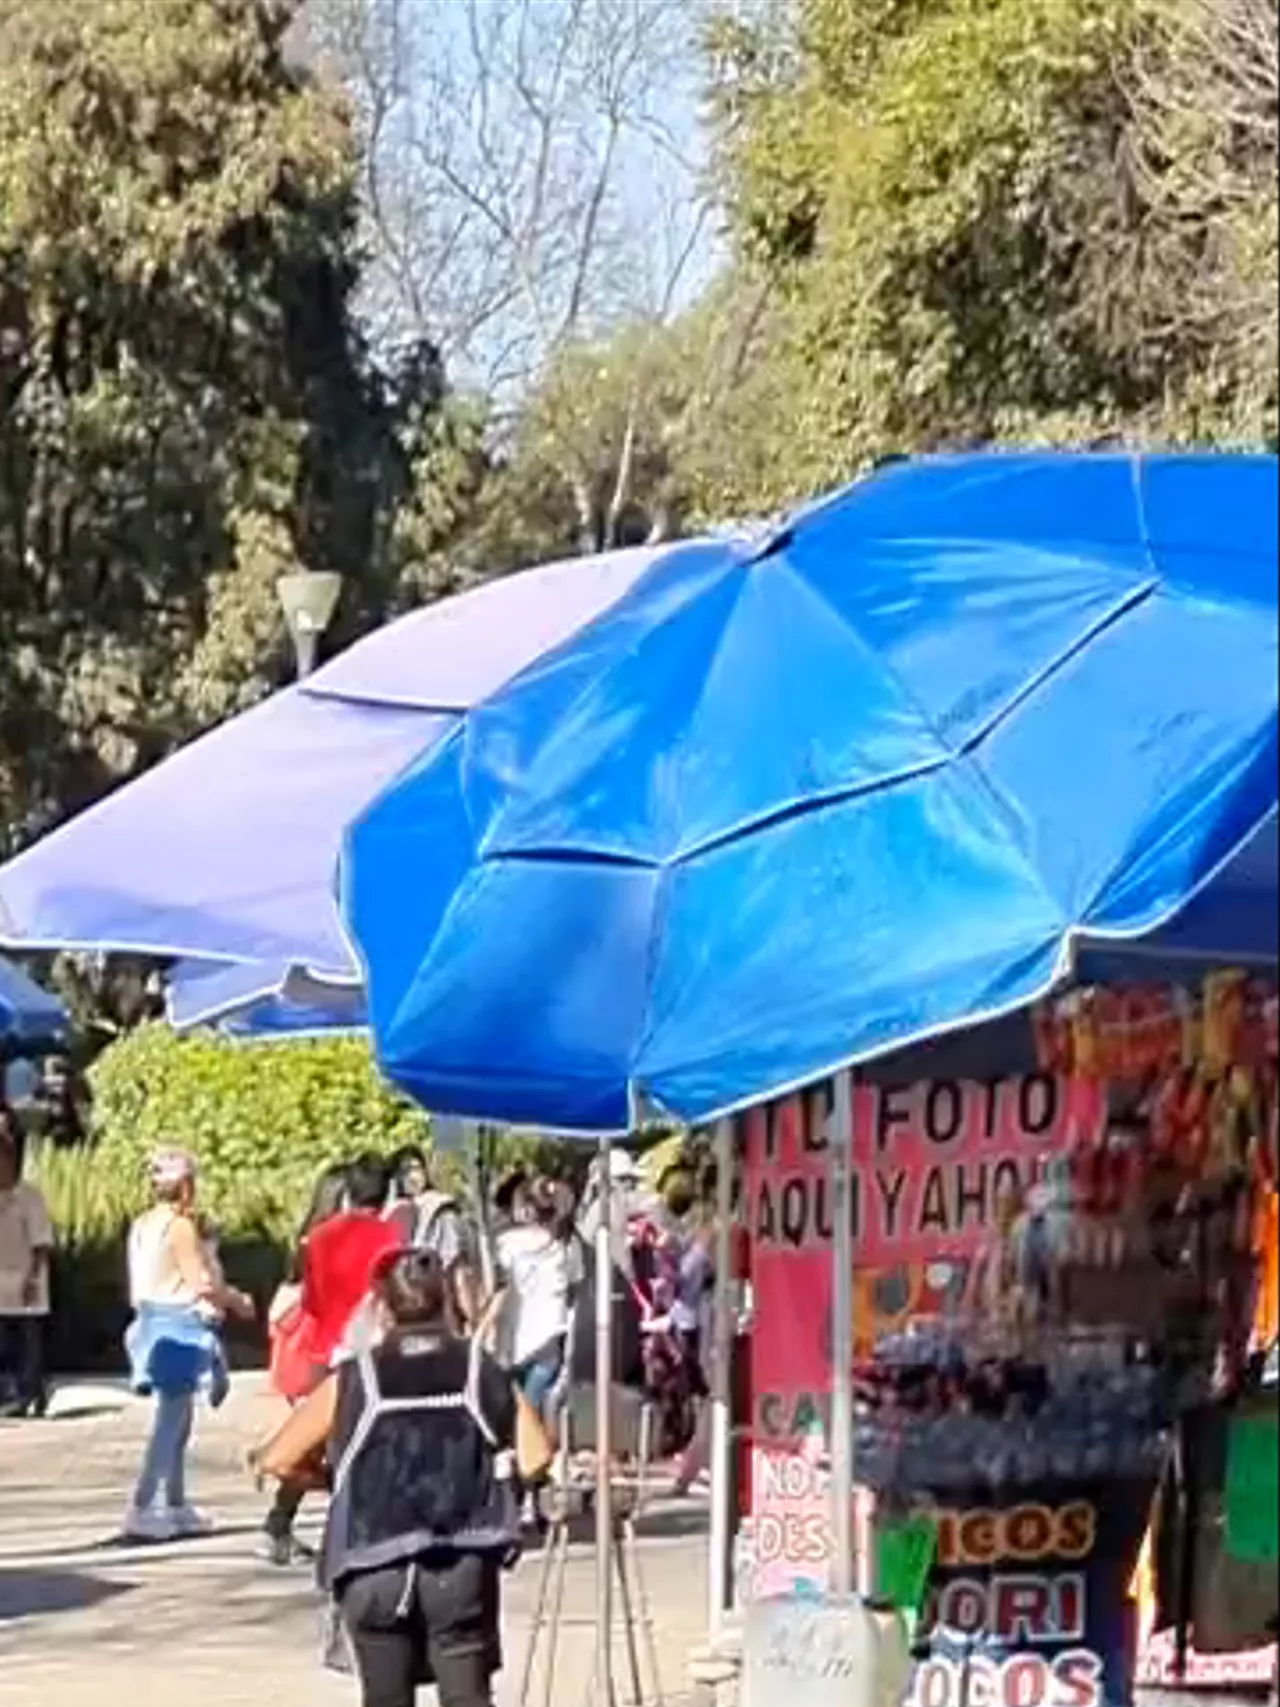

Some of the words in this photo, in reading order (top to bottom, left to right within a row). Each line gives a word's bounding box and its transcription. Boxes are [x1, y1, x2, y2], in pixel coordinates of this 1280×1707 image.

[877, 1070, 1057, 1151] FOTO
[757, 1171, 859, 1247] AQUI
[933, 1502, 1095, 1565] ICOS
